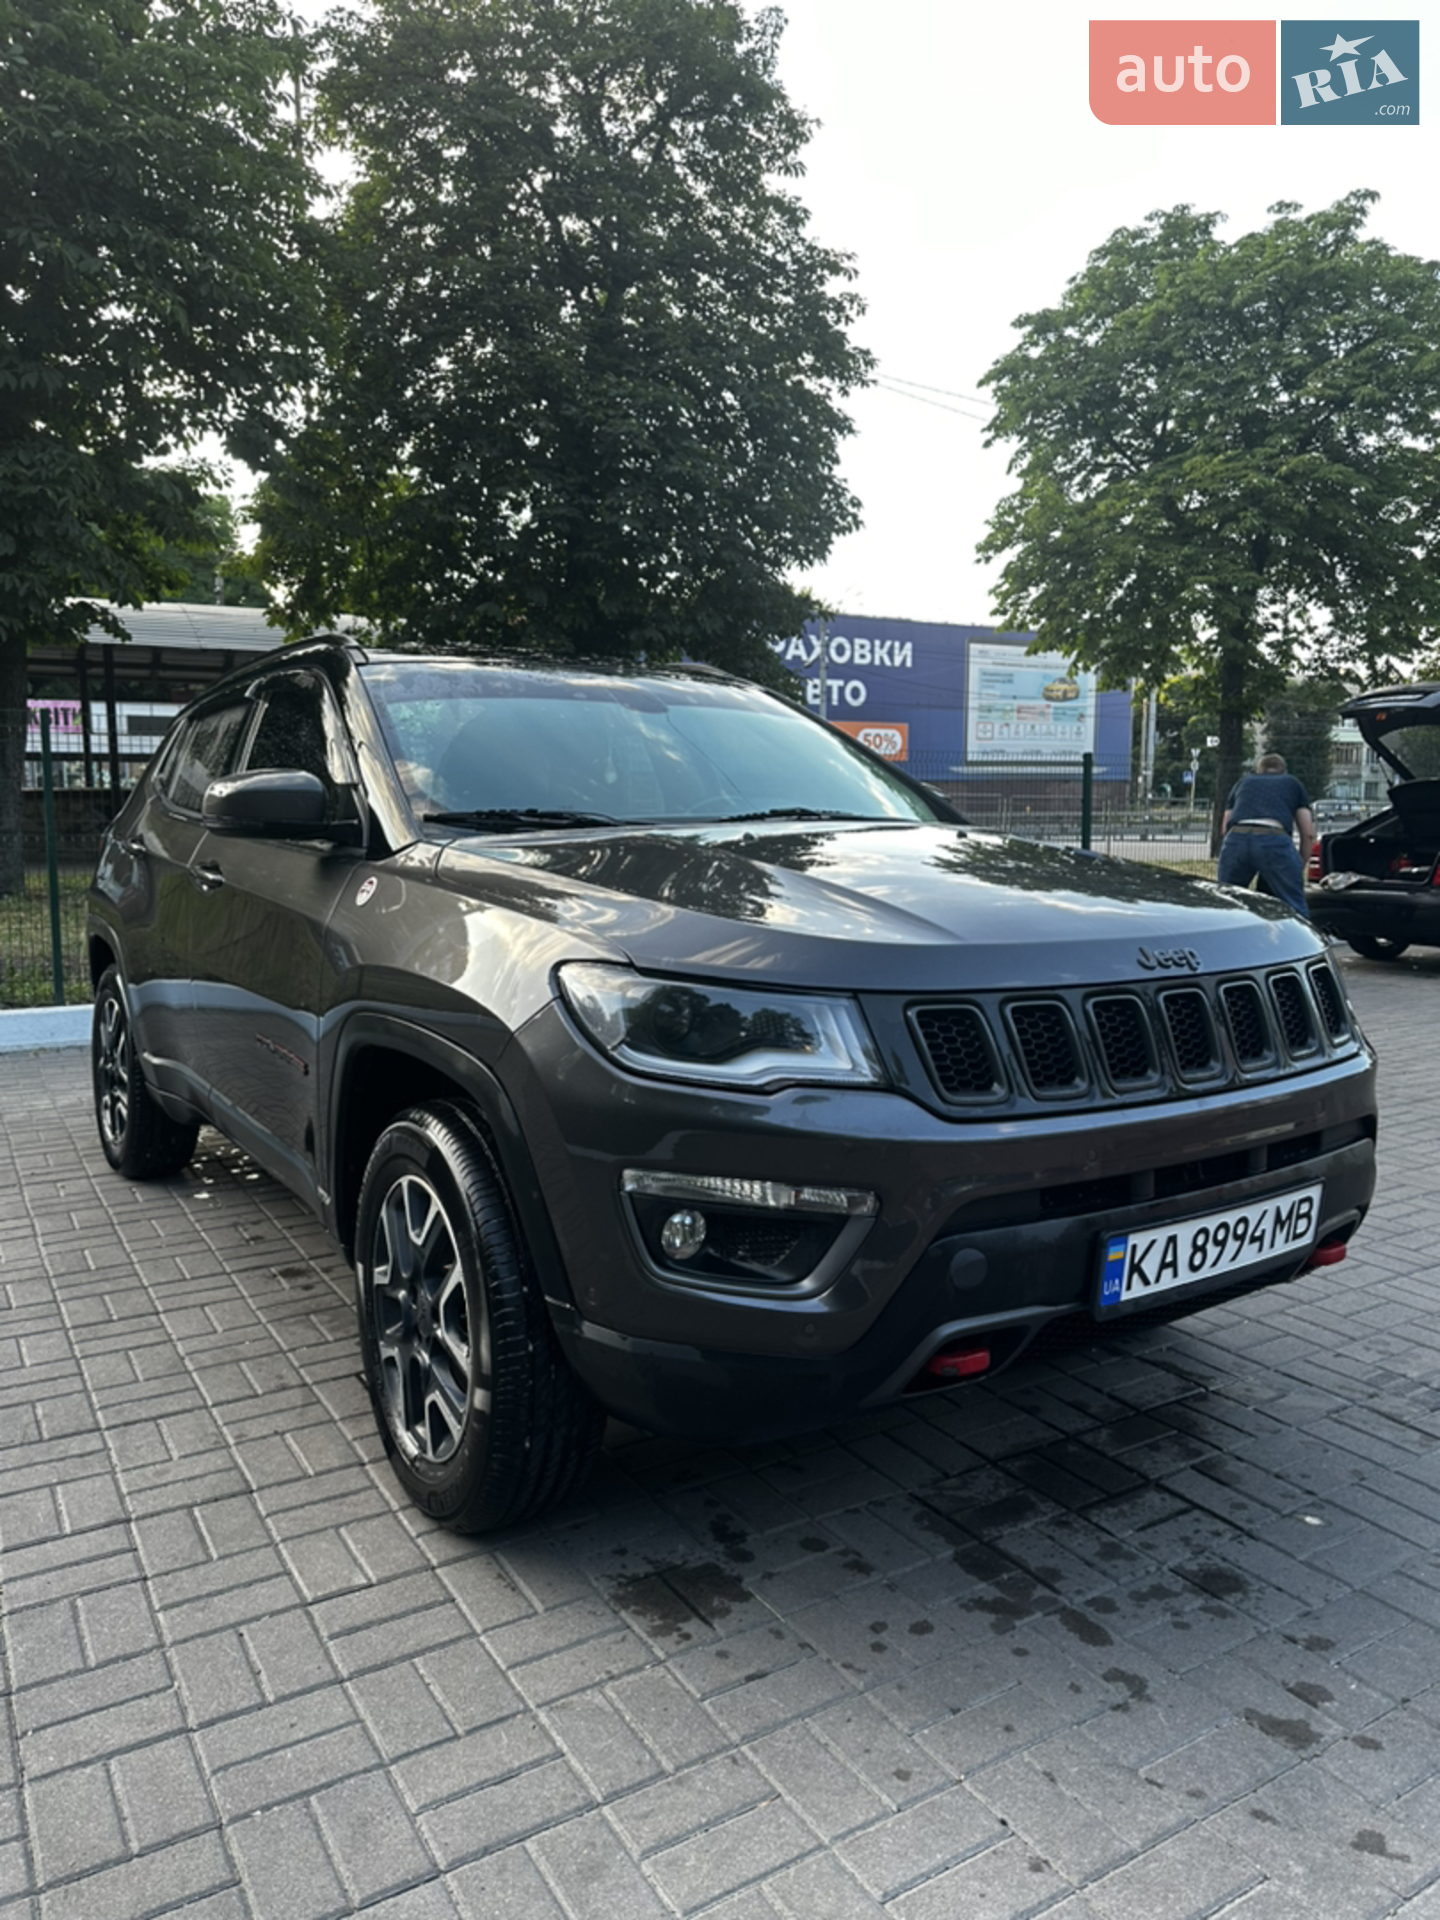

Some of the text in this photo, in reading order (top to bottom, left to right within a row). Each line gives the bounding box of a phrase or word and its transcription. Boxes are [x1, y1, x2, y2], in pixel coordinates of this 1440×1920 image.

[863, 732, 898, 750] 50%
[1136, 945, 1201, 973] Jeep
[1103, 1278, 1121, 1295] UA
